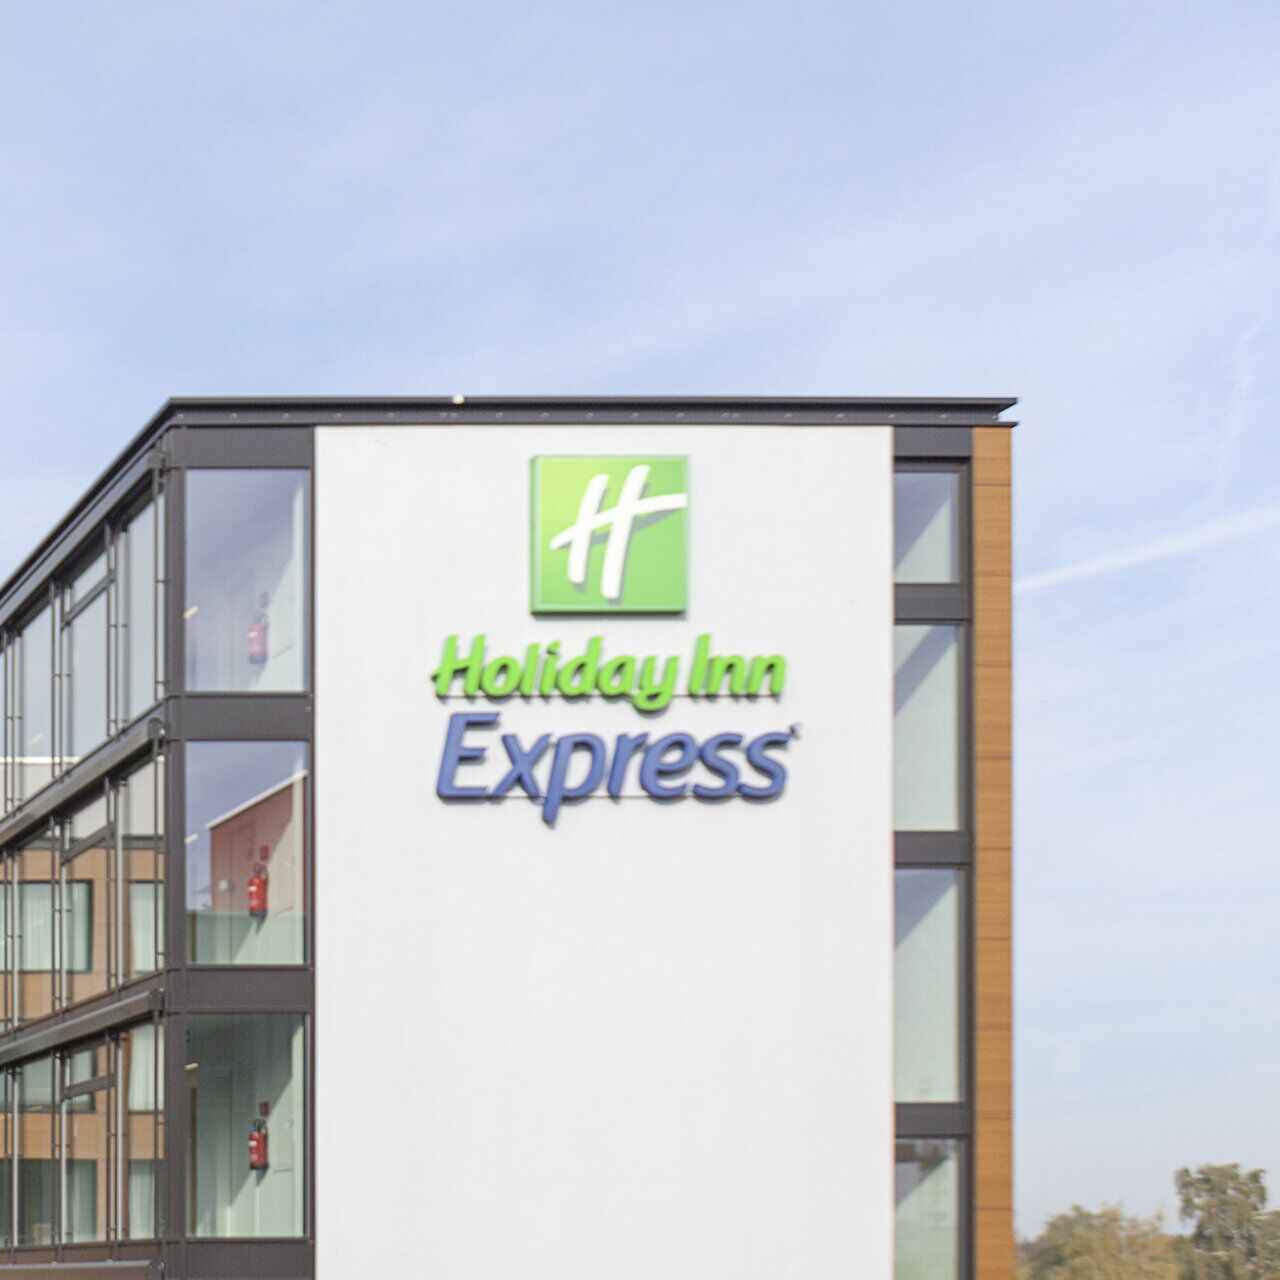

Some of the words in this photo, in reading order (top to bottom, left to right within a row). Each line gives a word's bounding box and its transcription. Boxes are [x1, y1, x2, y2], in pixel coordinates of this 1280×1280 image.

[431, 633, 678, 711] Holiday
[686, 633, 788, 700] Inn
[436, 711, 791, 827] Express
